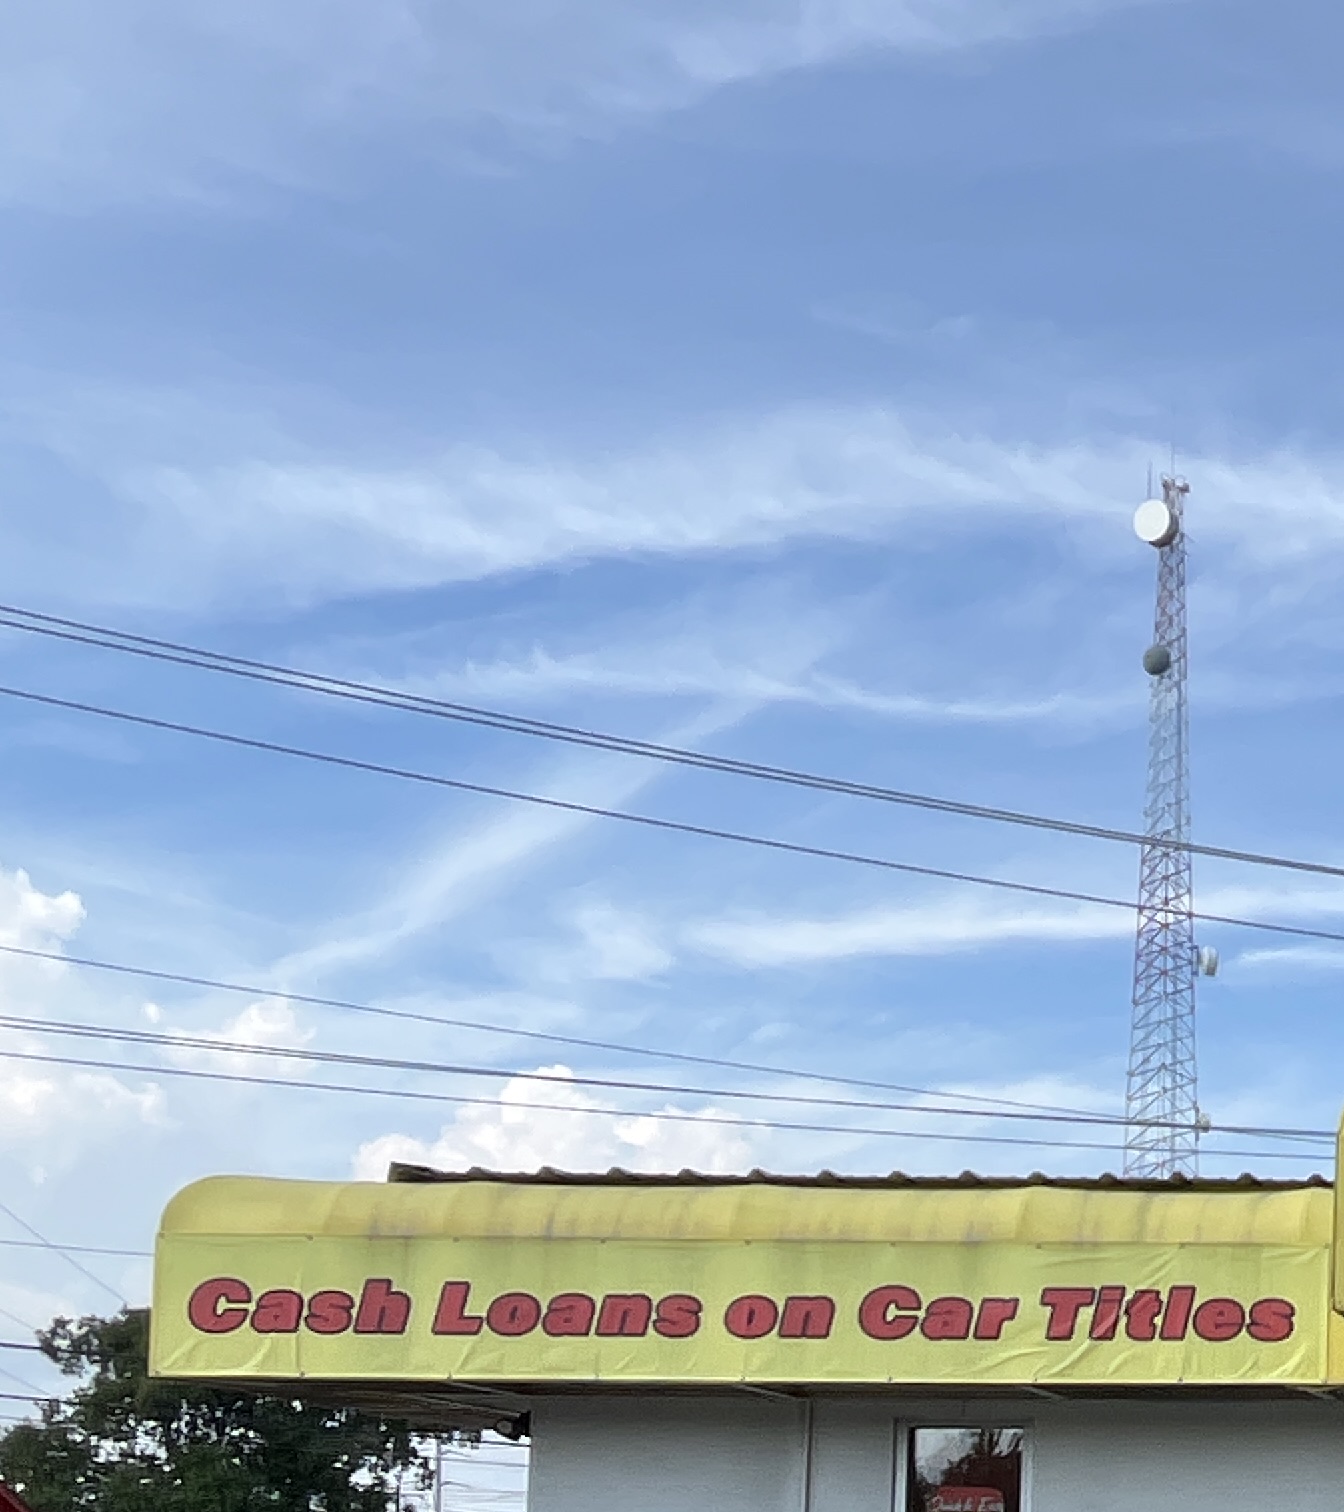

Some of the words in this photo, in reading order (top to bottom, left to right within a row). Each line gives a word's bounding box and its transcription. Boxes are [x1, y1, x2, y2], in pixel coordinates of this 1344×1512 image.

[188, 1277, 411, 1336] Cash
[432, 1280, 703, 1339] Loans
[724, 1294, 836, 1340] on
[858, 1285, 1020, 1341] Car
[1040, 1286, 1296, 1342] Titles
